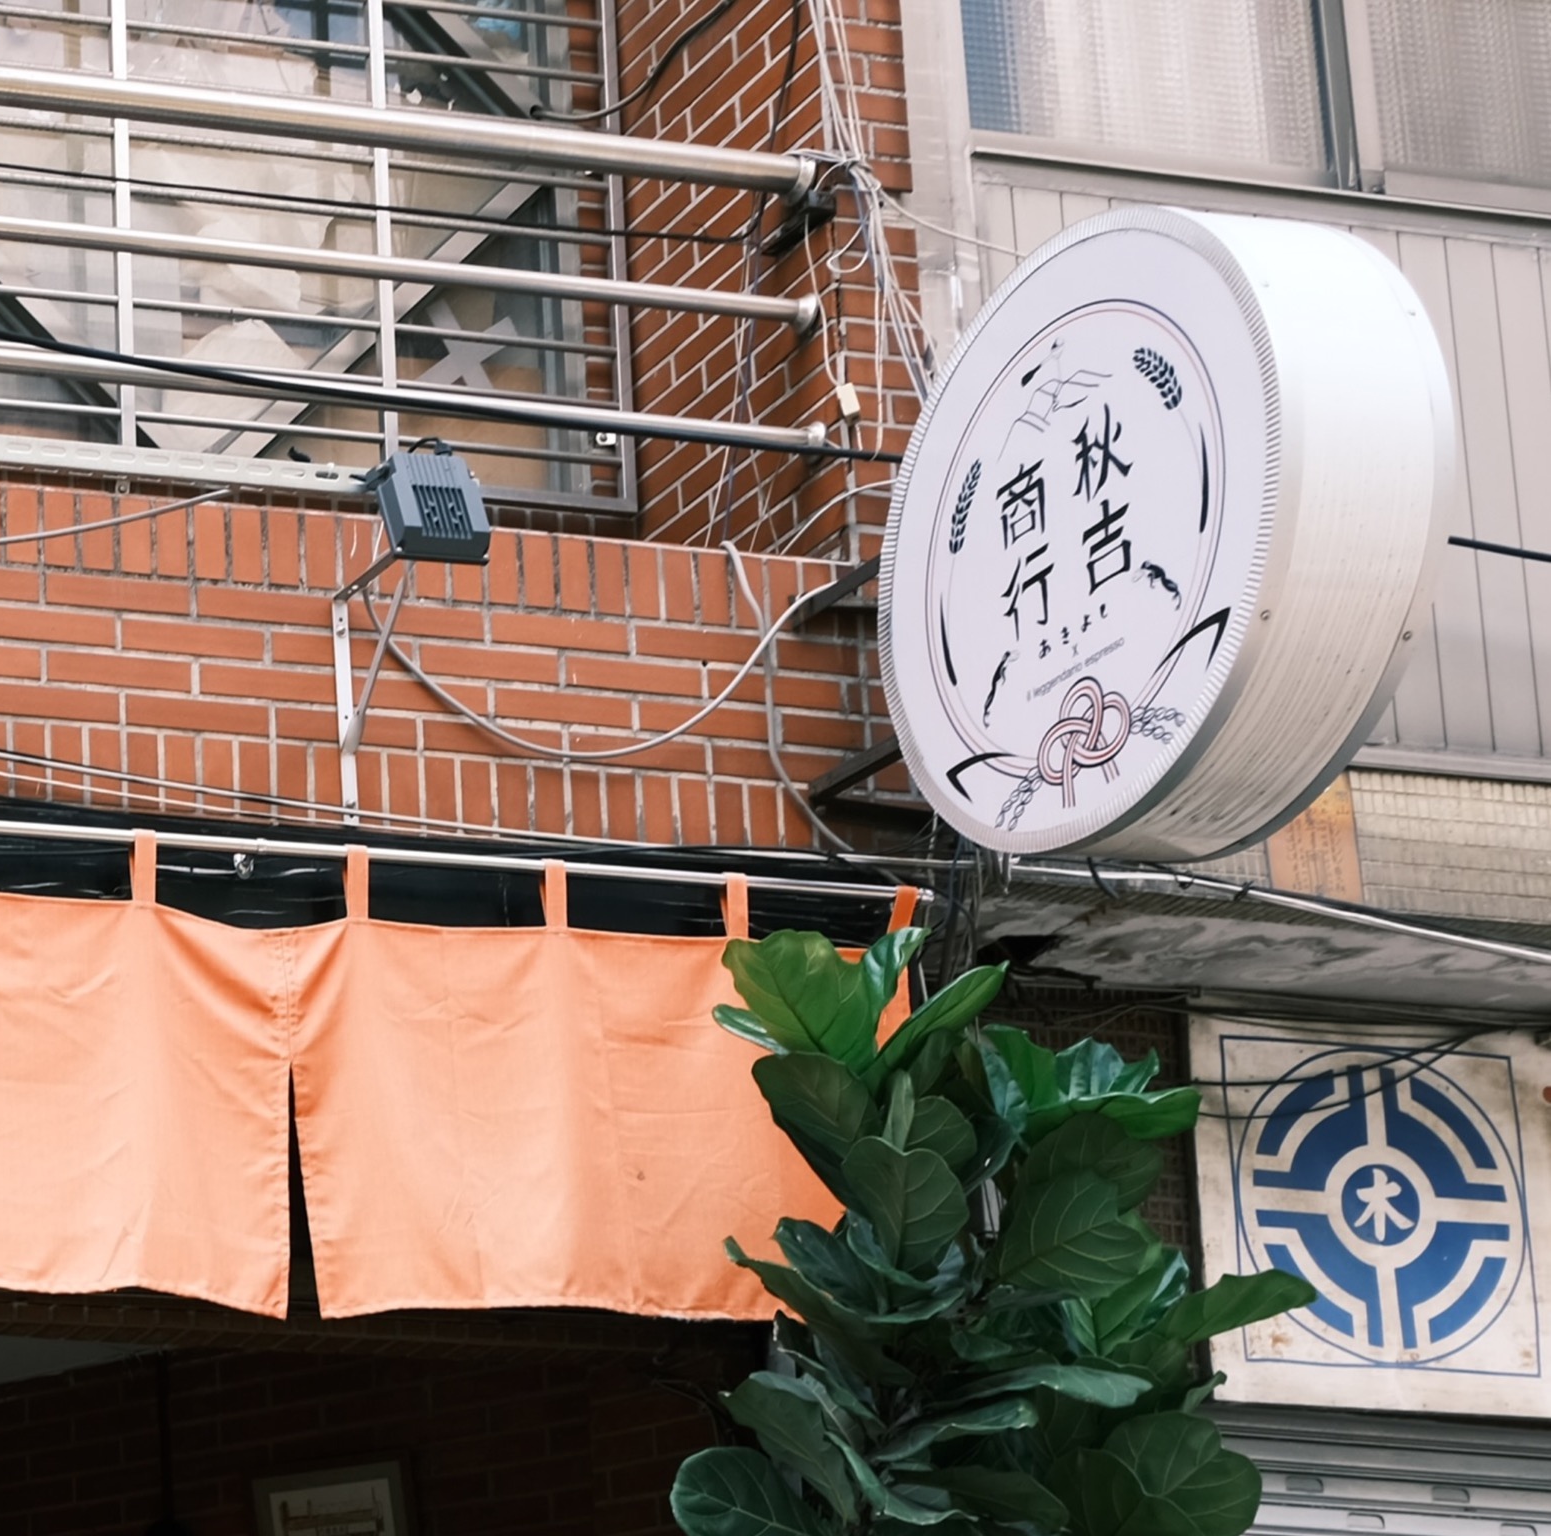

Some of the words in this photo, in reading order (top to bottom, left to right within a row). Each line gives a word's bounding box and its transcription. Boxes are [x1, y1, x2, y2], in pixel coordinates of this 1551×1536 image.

[1071, 402, 1134, 596] 秋吉
[996, 458, 1055, 642] 商行
[1039, 603, 1109, 659] あきよし
[1084, 637, 1126, 668] espresso
[1353, 1167, 1416, 1242] 木
